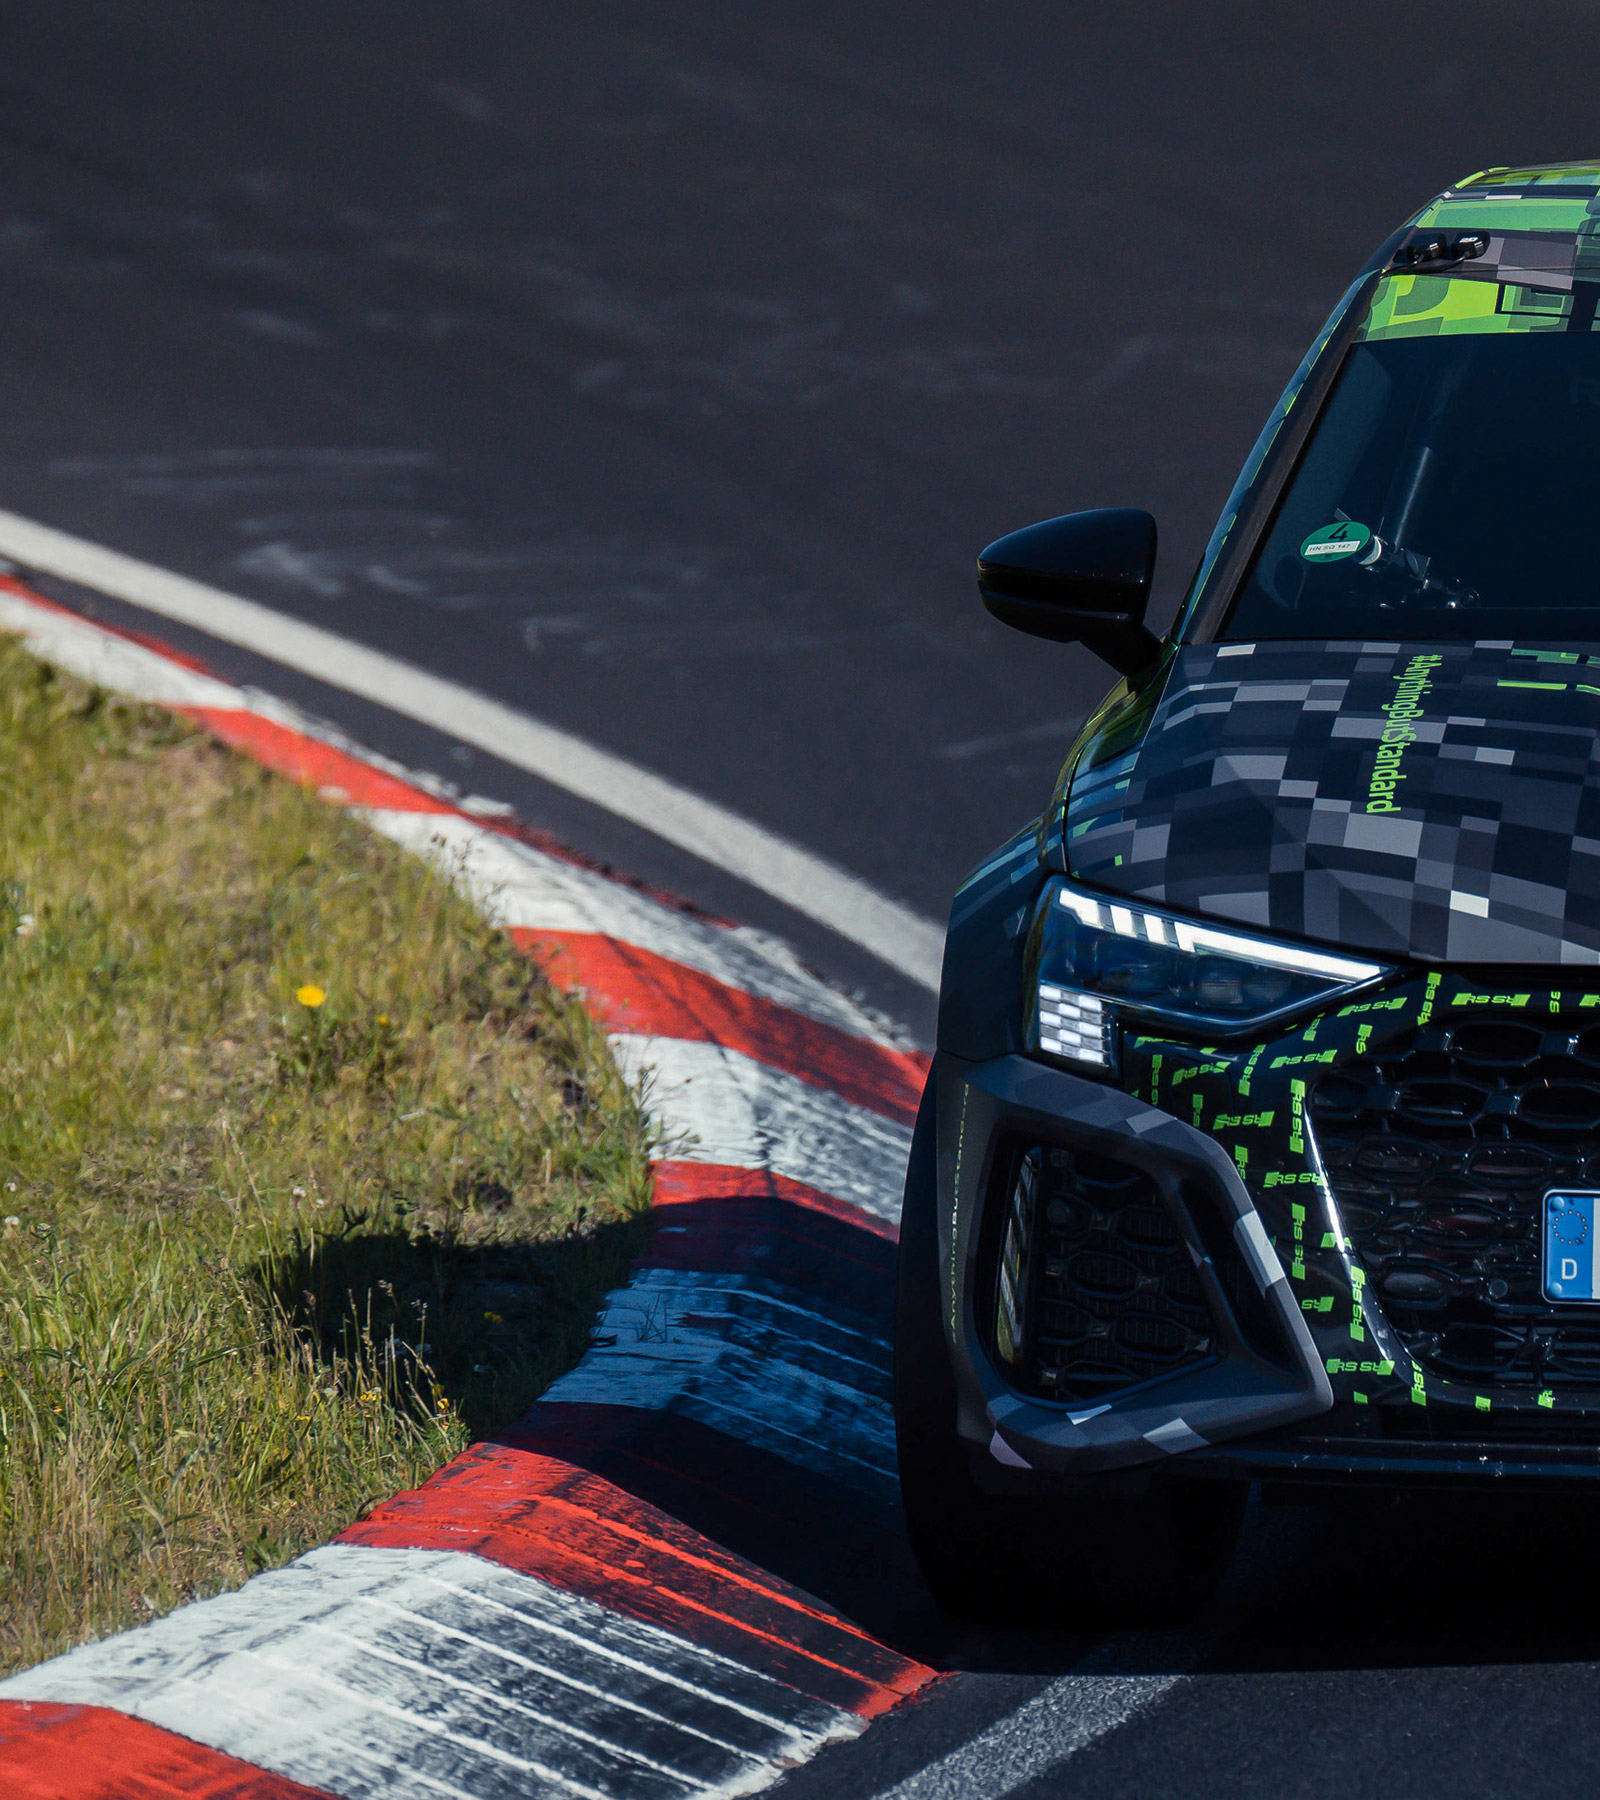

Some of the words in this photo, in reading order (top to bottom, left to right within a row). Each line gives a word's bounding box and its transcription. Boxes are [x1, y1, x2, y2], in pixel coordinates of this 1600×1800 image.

[1328, 522, 1350, 541] 4
[1366, 654, 1443, 813] #AnythingButStandard
[1561, 1258, 1578, 1280] D
